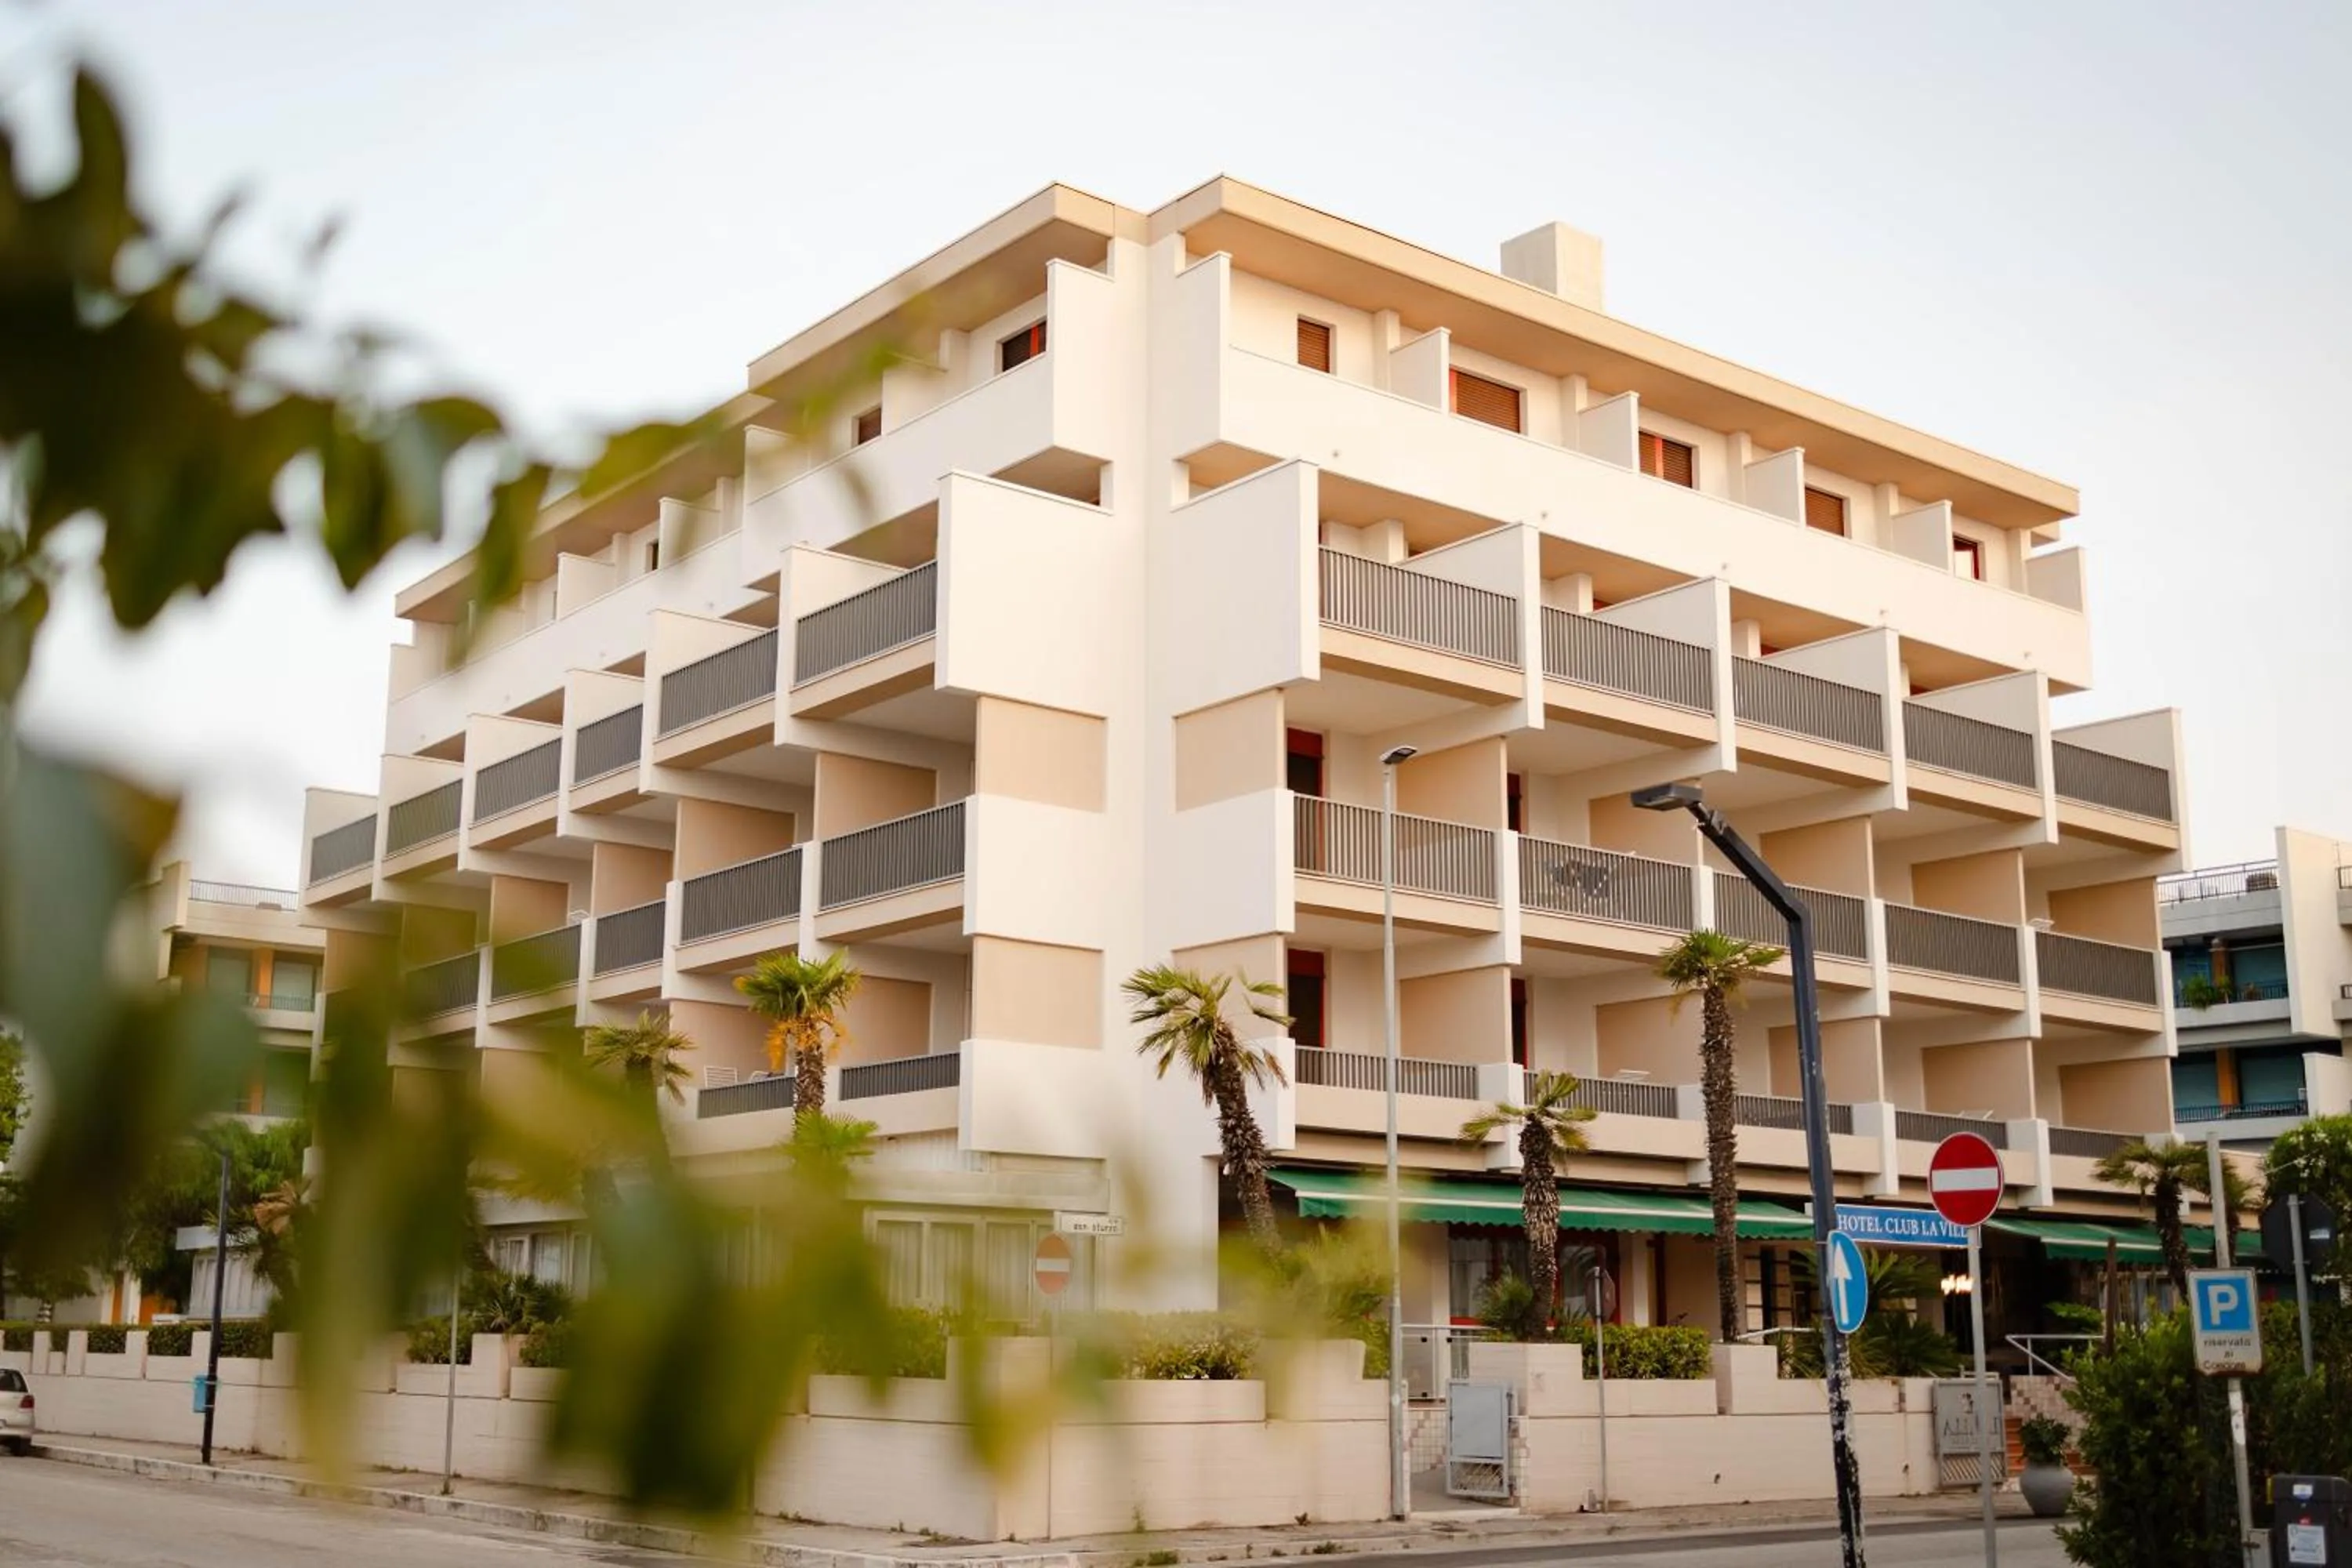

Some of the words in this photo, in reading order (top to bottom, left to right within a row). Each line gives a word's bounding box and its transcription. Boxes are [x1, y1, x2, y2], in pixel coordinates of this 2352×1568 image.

[1838, 1215, 1882, 1232] HOTEL
[1885, 1217, 1918, 1235] CLUB
[1922, 1220, 1938, 1236] LA
[1939, 1221, 1968, 1238] VILL
[2208, 1284, 2238, 1325] P
